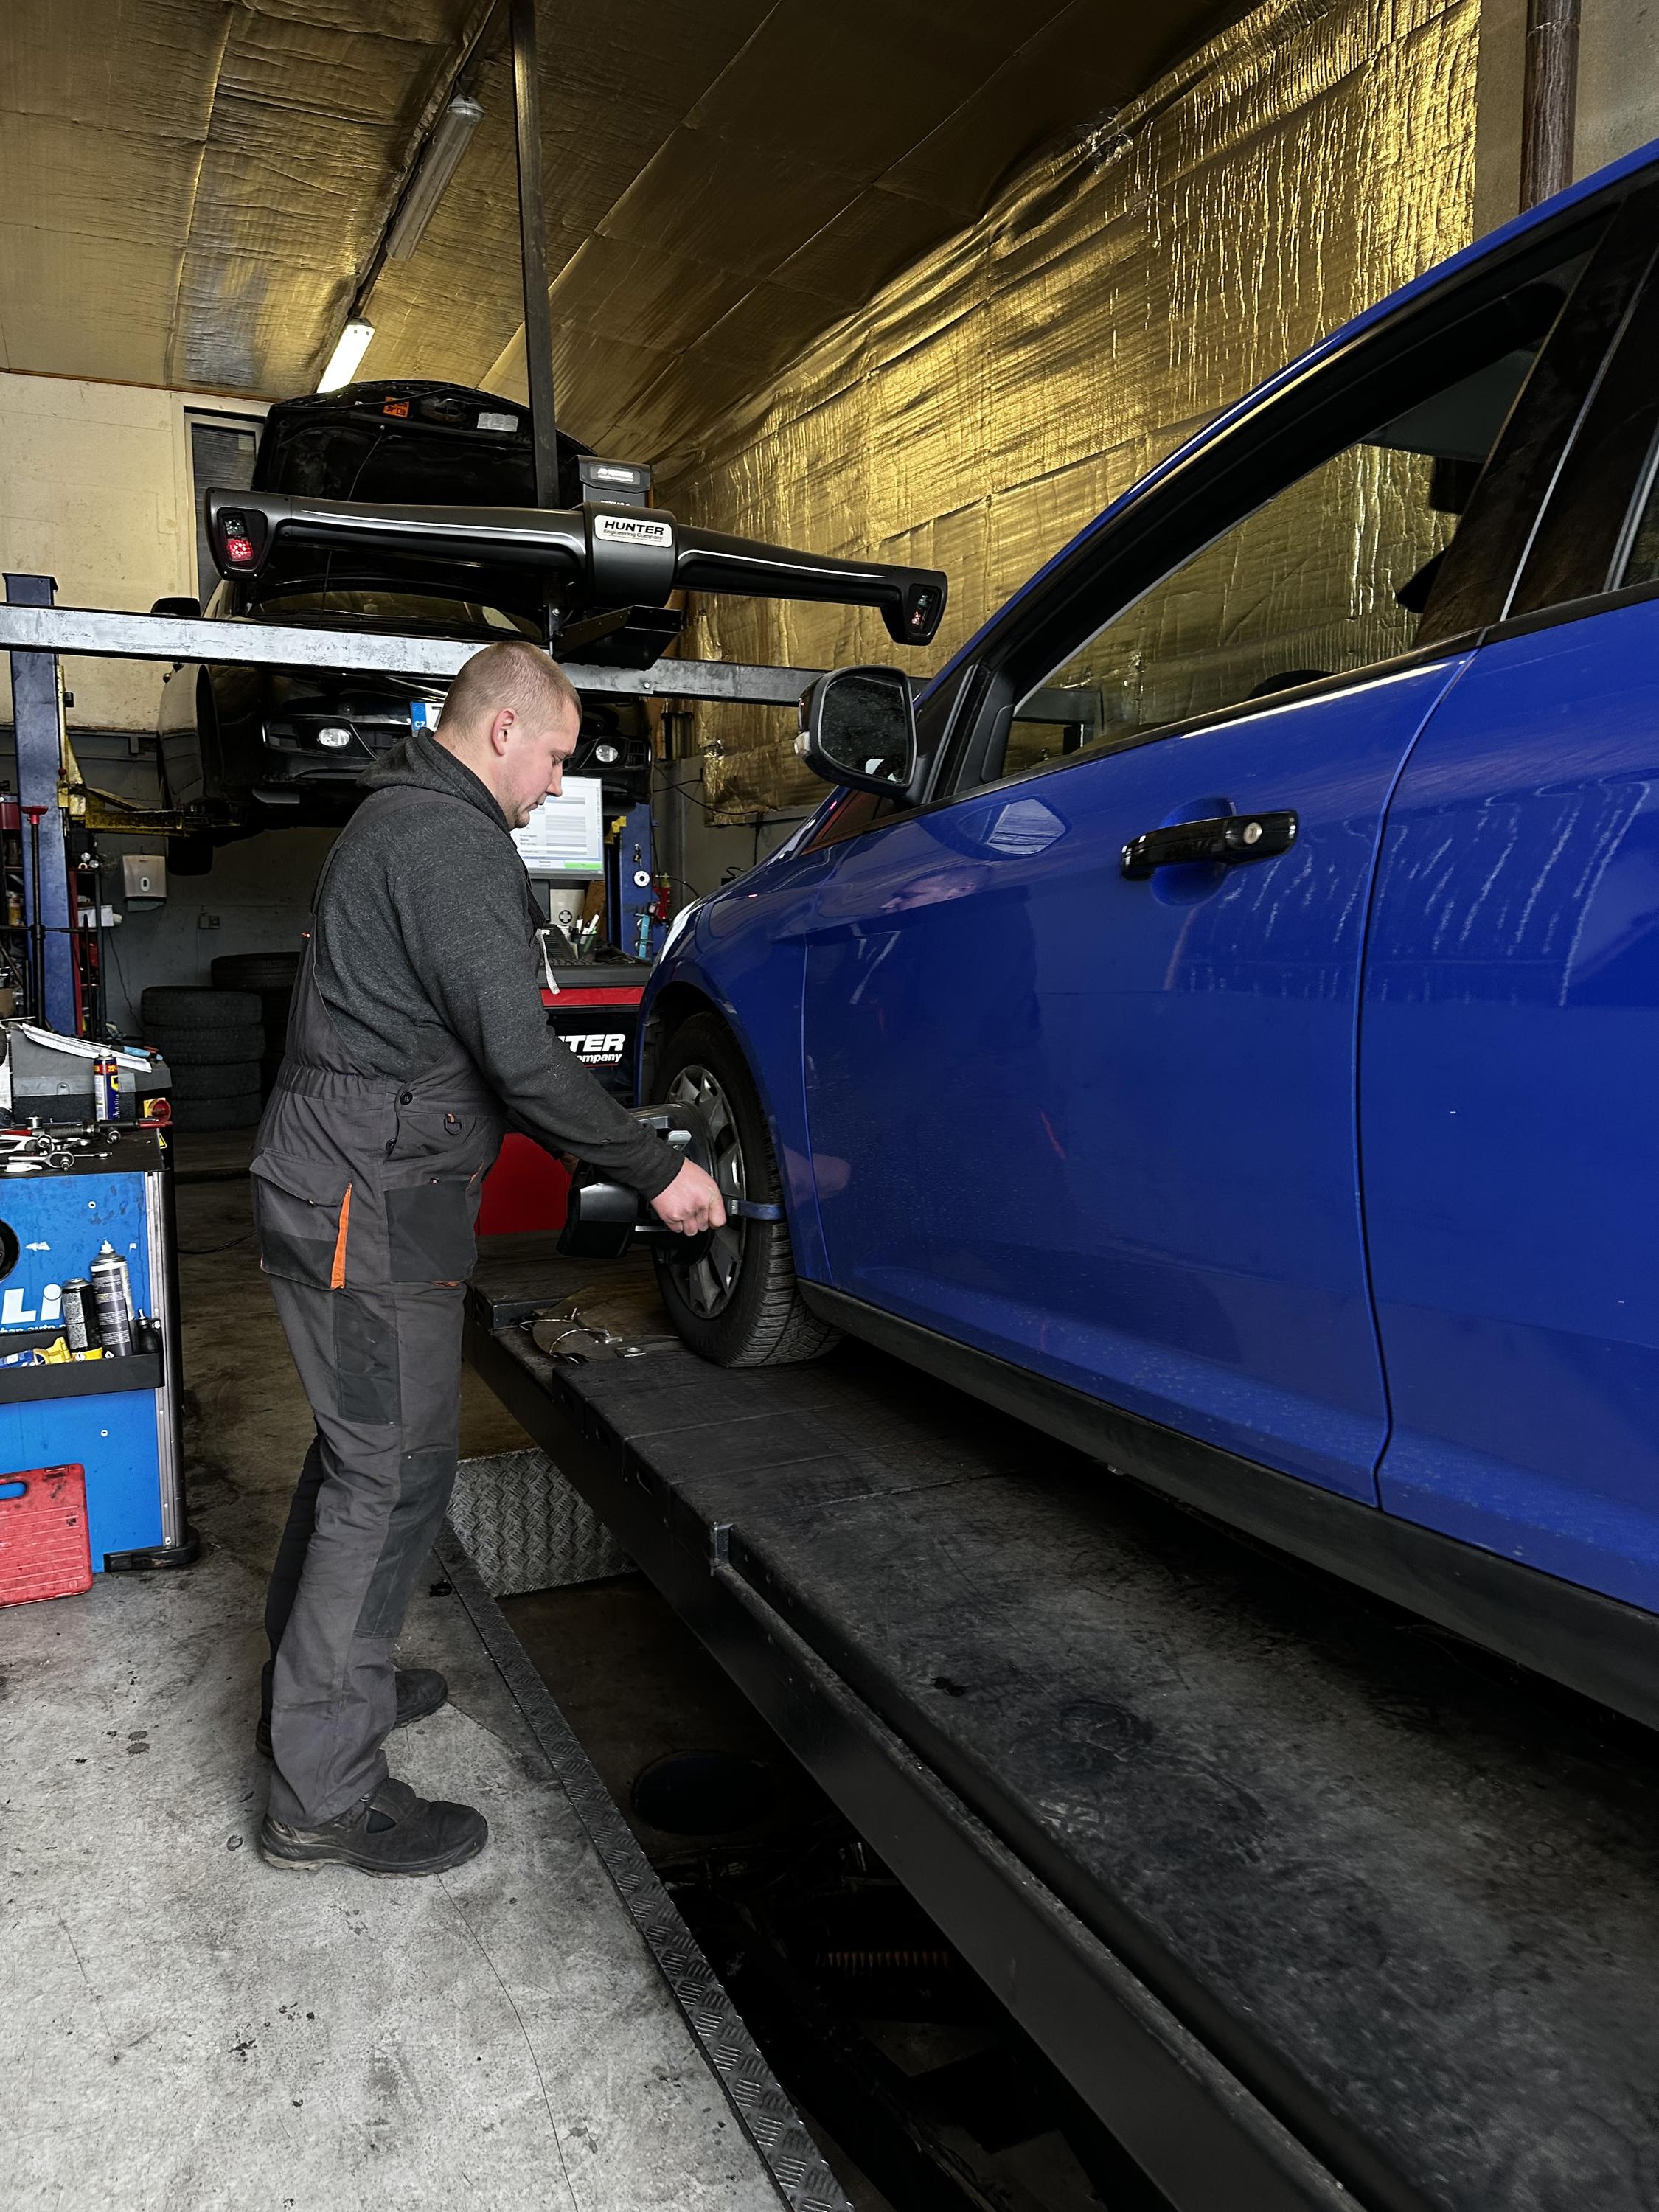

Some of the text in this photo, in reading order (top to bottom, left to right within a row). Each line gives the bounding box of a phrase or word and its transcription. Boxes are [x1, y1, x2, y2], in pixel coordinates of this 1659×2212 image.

[603, 529, 663, 541] Engineering Company
[605, 520, 664, 535] HUNTER
[557, 1034, 626, 1053] TER
